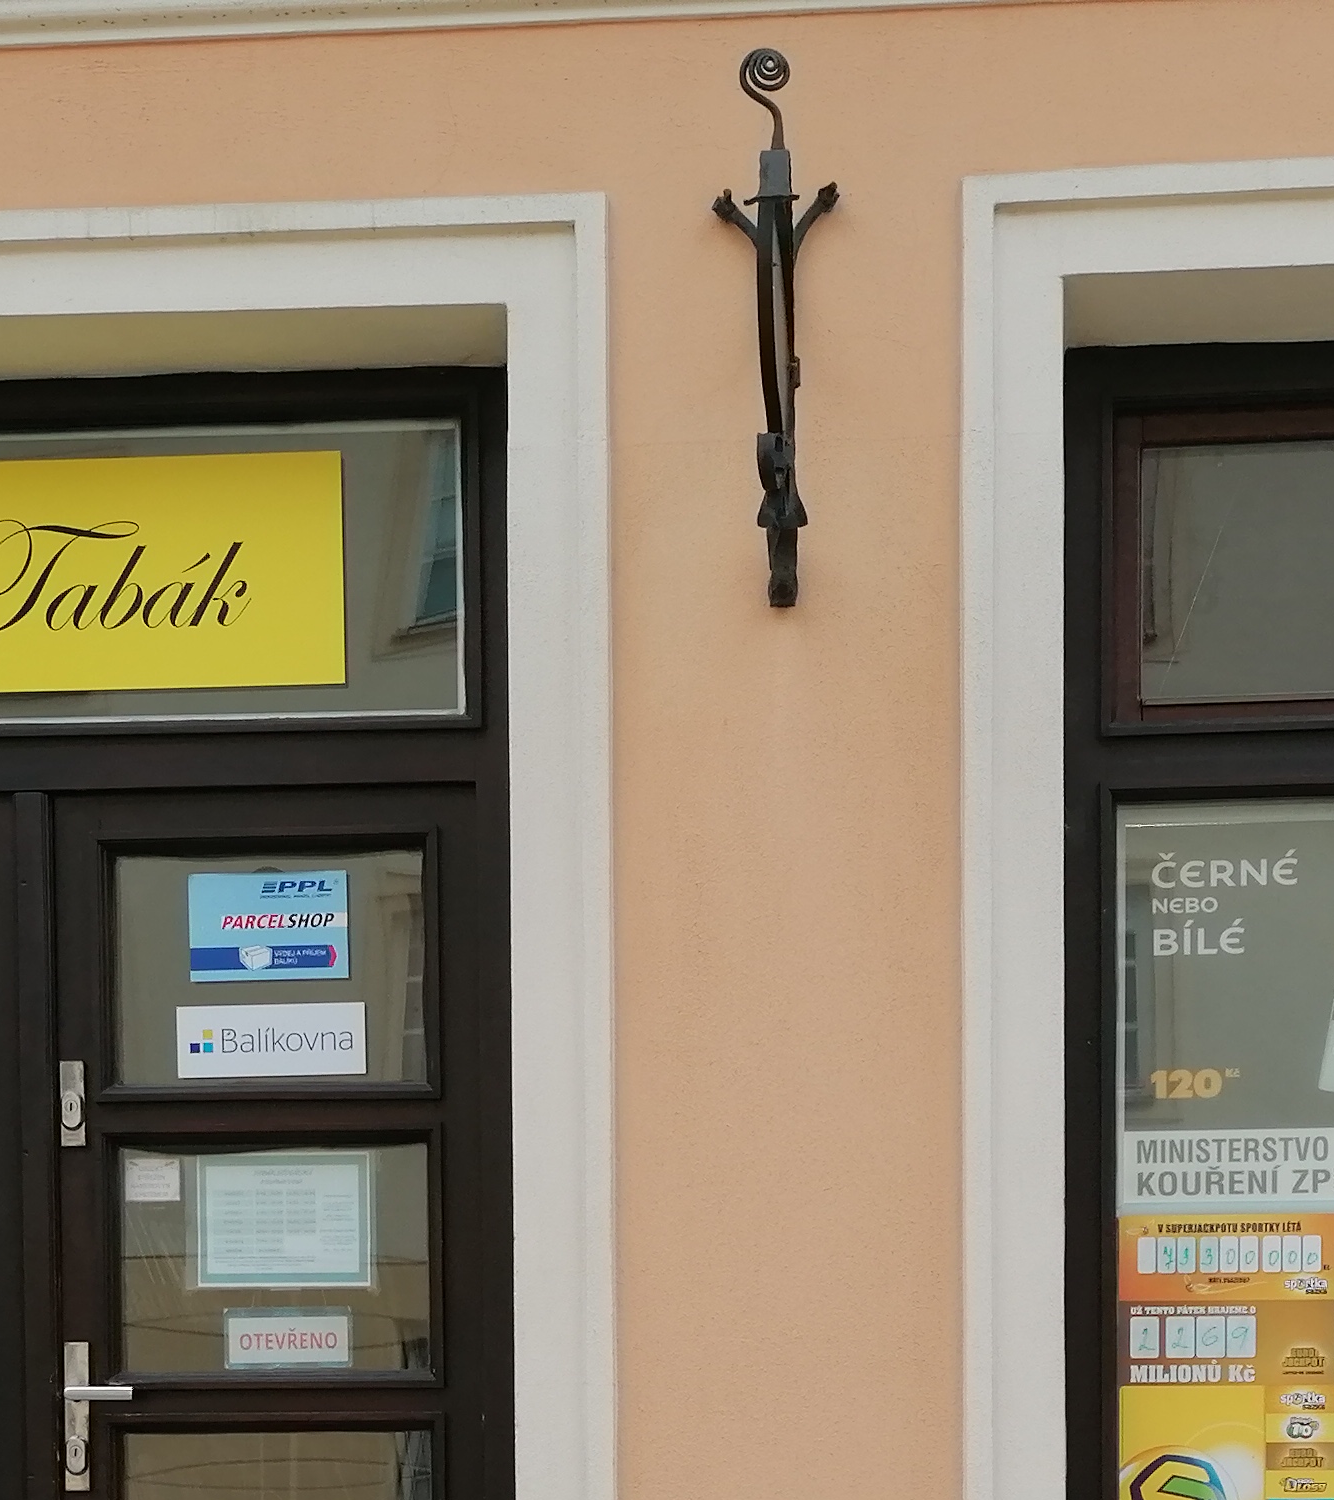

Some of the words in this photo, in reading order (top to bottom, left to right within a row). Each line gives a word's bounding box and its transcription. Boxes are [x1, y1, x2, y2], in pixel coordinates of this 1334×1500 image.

[1151, 848, 1300, 889] ČERNÉ
[278, 880, 333, 893] PPL
[1152, 896, 1219, 914] NEBO
[221, 913, 335, 930] PARCELSHOP
[1152, 918, 1247, 957] BÍLÉ
[221, 1026, 355, 1056] Balíkovna
[1150, 1067, 1223, 1100] 120
[1136, 1136, 1330, 1165] MINISTERSTVO
[1136, 1163, 1279, 1197] KOUŘENÍ
[1240, 1221, 1280, 1232] SPORTKY
[239, 1327, 339, 1351] OTEVŘENO
[1130, 1360, 1222, 1383] MILIONŮ
[1228, 1365, 1256, 1382] Kč
